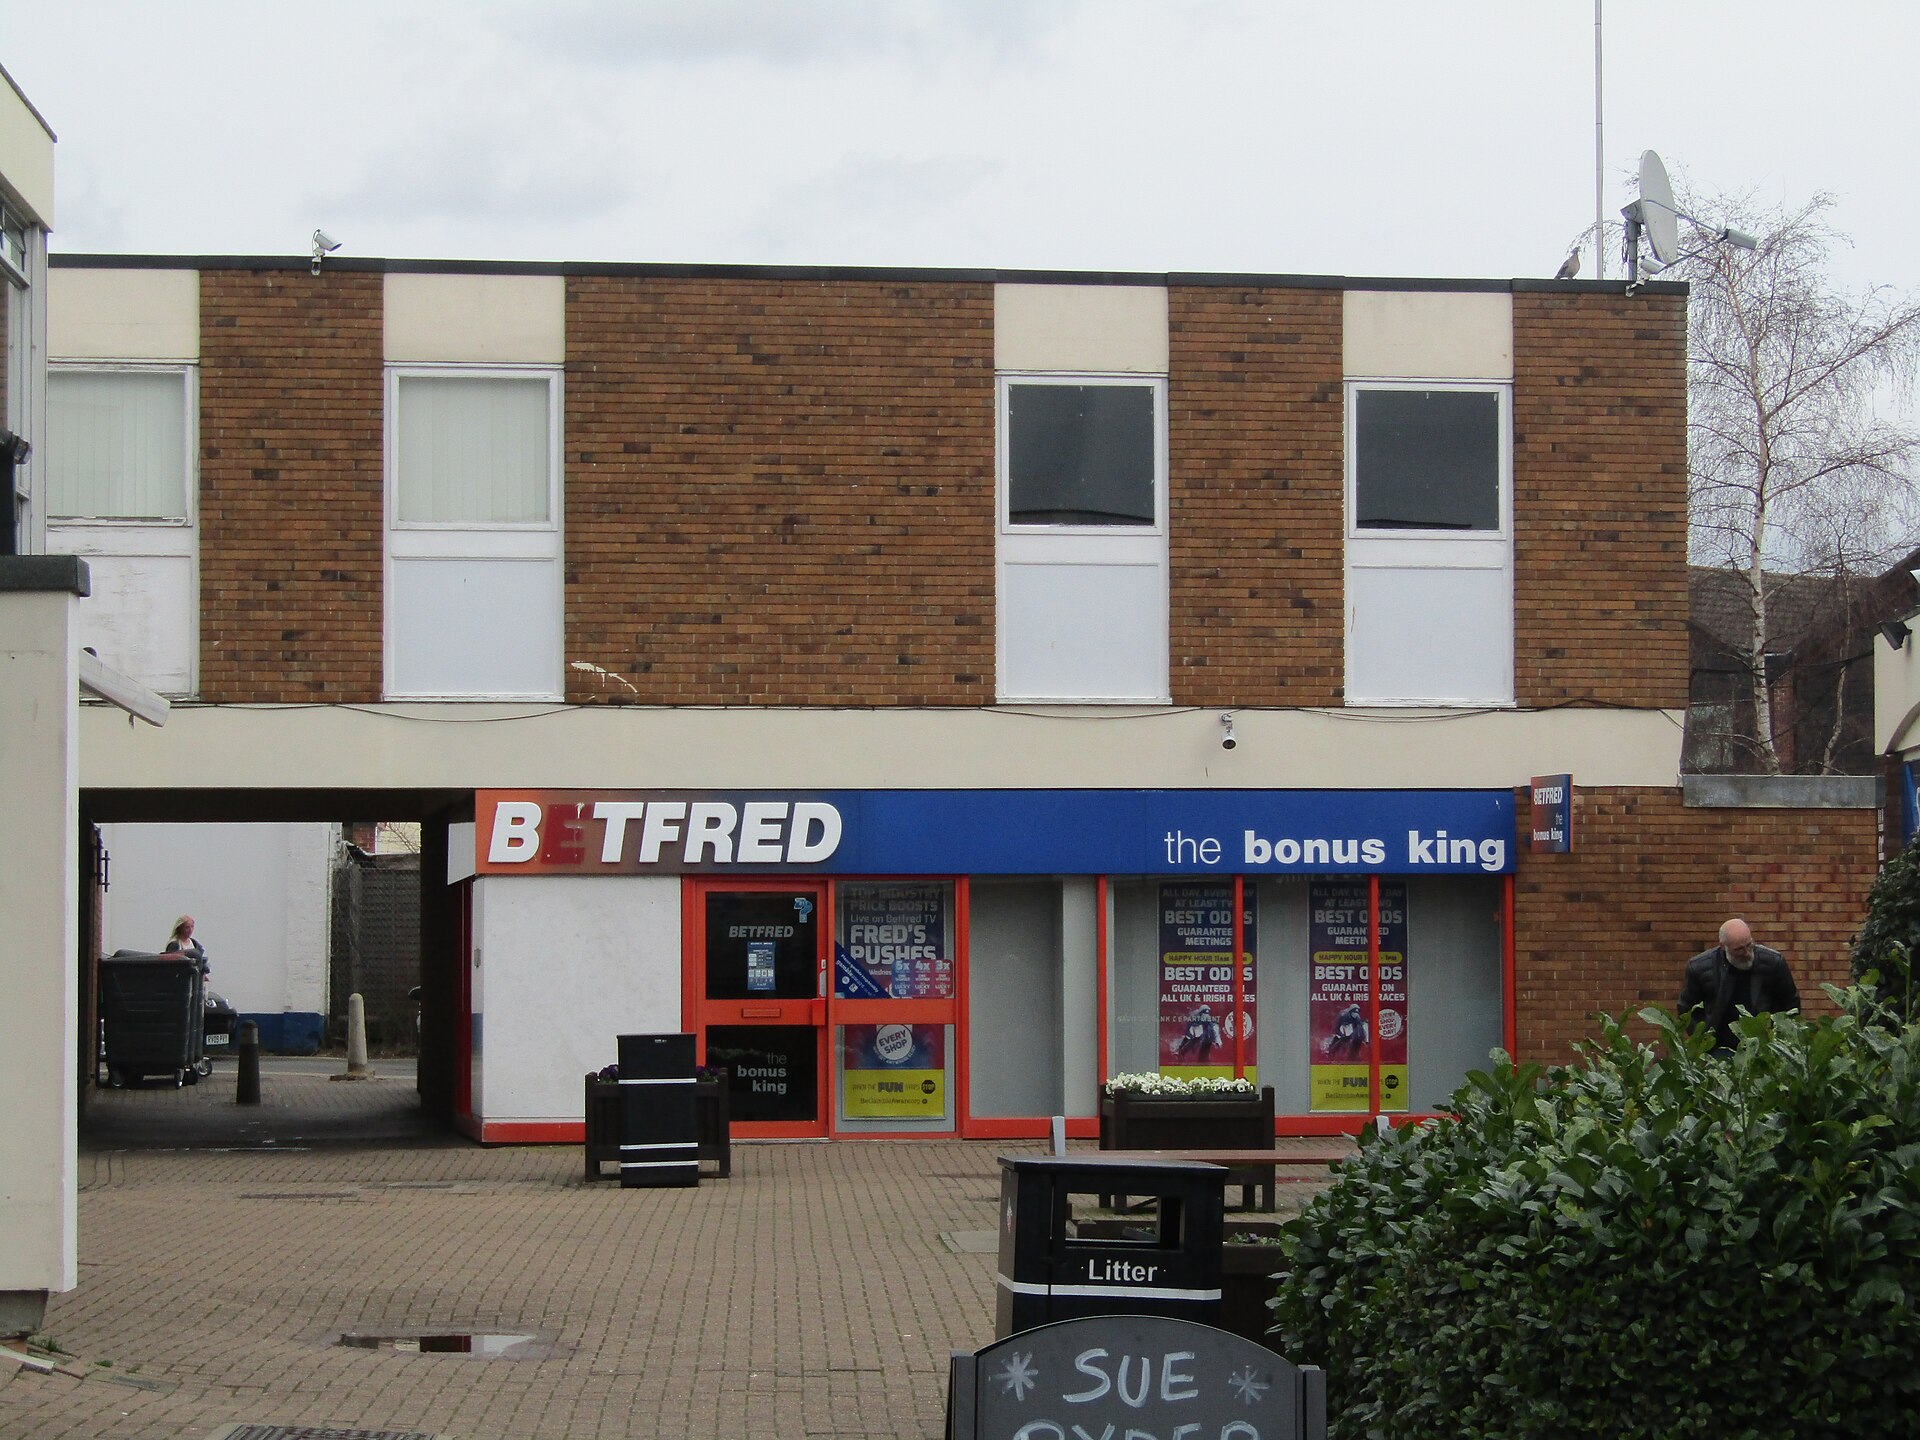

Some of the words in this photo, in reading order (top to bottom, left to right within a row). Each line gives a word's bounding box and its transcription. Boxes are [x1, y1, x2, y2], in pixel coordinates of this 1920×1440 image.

[1533, 787, 1563, 805] BETFRED
[1533, 829, 1550, 841] bonus
[1550, 828, 1564, 843] king
[1164, 831, 1221, 864] the
[1244, 830, 1386, 864] bonus
[1408, 830, 1505, 871] king
[850, 900, 886, 911] PRICE
[888, 900, 938, 912] BOOSTS
[1175, 899, 1186, 907] AT
[1189, 899, 1217, 907] LEAST
[1324, 899, 1336, 907] AT
[1338, 899, 1367, 907] LEAST
[850, 914, 870, 923] Live
[872, 916, 884, 924] on
[886, 914, 922, 924] Betfred
[923, 914, 937, 924] TV
[1164, 911, 1205, 924] BEST
[1209, 911, 1253, 924] ODS
[1314, 910, 1354, 924] BEST
[1358, 910, 1403, 924] ODS
[728, 925, 794, 938] BETFRED
[850, 924, 927, 944] FRED'S
[1177, 928, 1233, 936] GUARANTEE
[1327, 927, 1389, 935] GUARANED
[1185, 937, 1232, 946] MEETINGS
[1335, 936, 1382, 945] MEETINS
[850, 945, 937, 965] PUSHES
[1164, 967, 1205, 981] BEST
[1209, 967, 1253, 981] ODS
[1314, 966, 1354, 980] BEST
[1359, 966, 1402, 980] ODS
[1171, 984, 1230, 992] GUARANTEED
[1321, 984, 1369, 992] GUARANTE
[1381, 984, 1394, 992] ON
[1161, 994, 1179, 1002] ALL
[1180, 994, 1192, 1002] UK
[1193, 994, 1201, 1002] &
[1203, 994, 1226, 1002] IRISH
[1311, 993, 1328, 1001] ALL
[1330, 993, 1342, 1001] UK
[1344, 993, 1351, 1001] &
[1353, 993, 1369, 1001] IRIS
[879, 1029, 907, 1047] EVERY
[884, 1038, 908, 1054] SHOP
[766, 1052, 787, 1064] the
[737, 1065, 787, 1077] bonus
[752, 1080, 787, 1095] king
[877, 1082, 904, 1092] FUN
[1343, 1077, 1368, 1087] FUN
[1088, 1259, 1158, 1282] Litter
[1063, 1348, 1199, 1408] SUE
